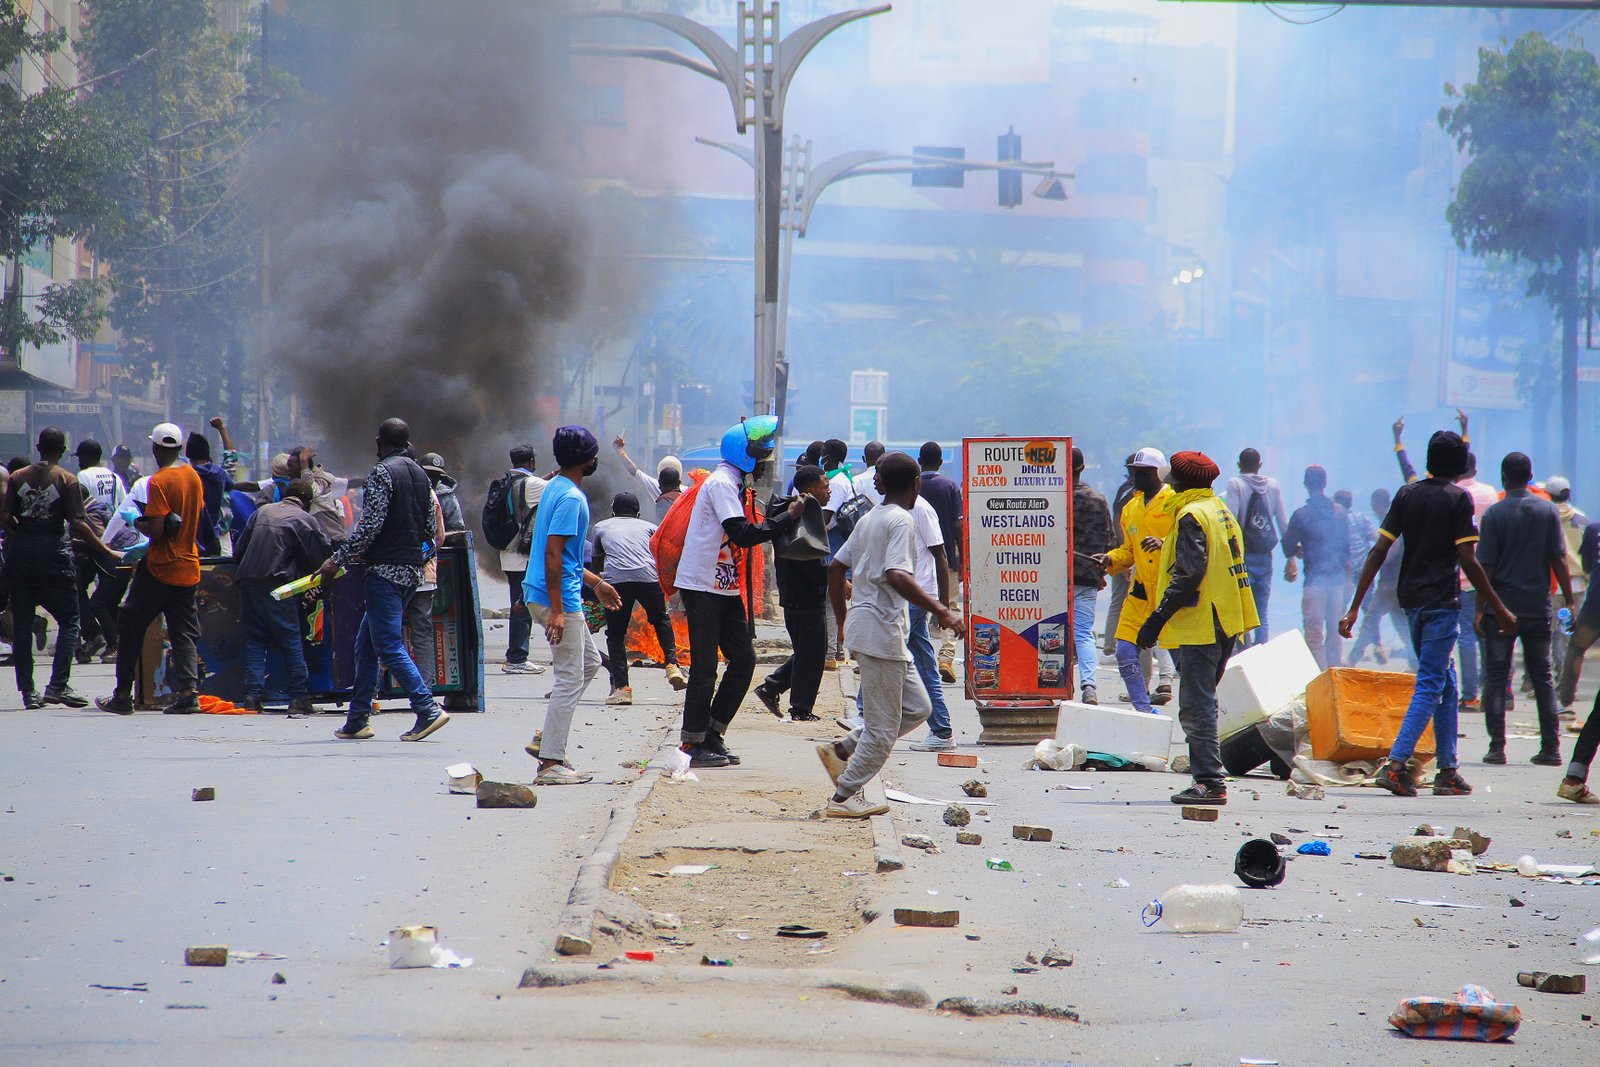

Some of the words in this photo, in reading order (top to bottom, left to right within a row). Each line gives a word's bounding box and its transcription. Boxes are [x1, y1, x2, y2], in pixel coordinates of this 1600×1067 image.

[76, 404, 98, 412] STREET
[984, 447, 1025, 462] ROUTE
[977, 464, 1003, 475] KMO
[1021, 464, 1057, 474] DIGITAL
[971, 476, 1008, 487] SACCO
[1014, 476, 1047, 486] LUXURY
[1048, 476, 1064, 486] LTD
[989, 499, 1005, 509] New
[1006, 499, 1026, 509] Route
[1028, 499, 1046, 509] Alert
[981, 515, 1055, 528] WESTLANDS
[991, 533, 1046, 546] KANGEMI
[996, 552, 1041, 565] UTHIRU
[1001, 570, 1038, 583] KINOO
[1000, 589, 1039, 601] REGEN
[998, 608, 1043, 620] KIKUYU
